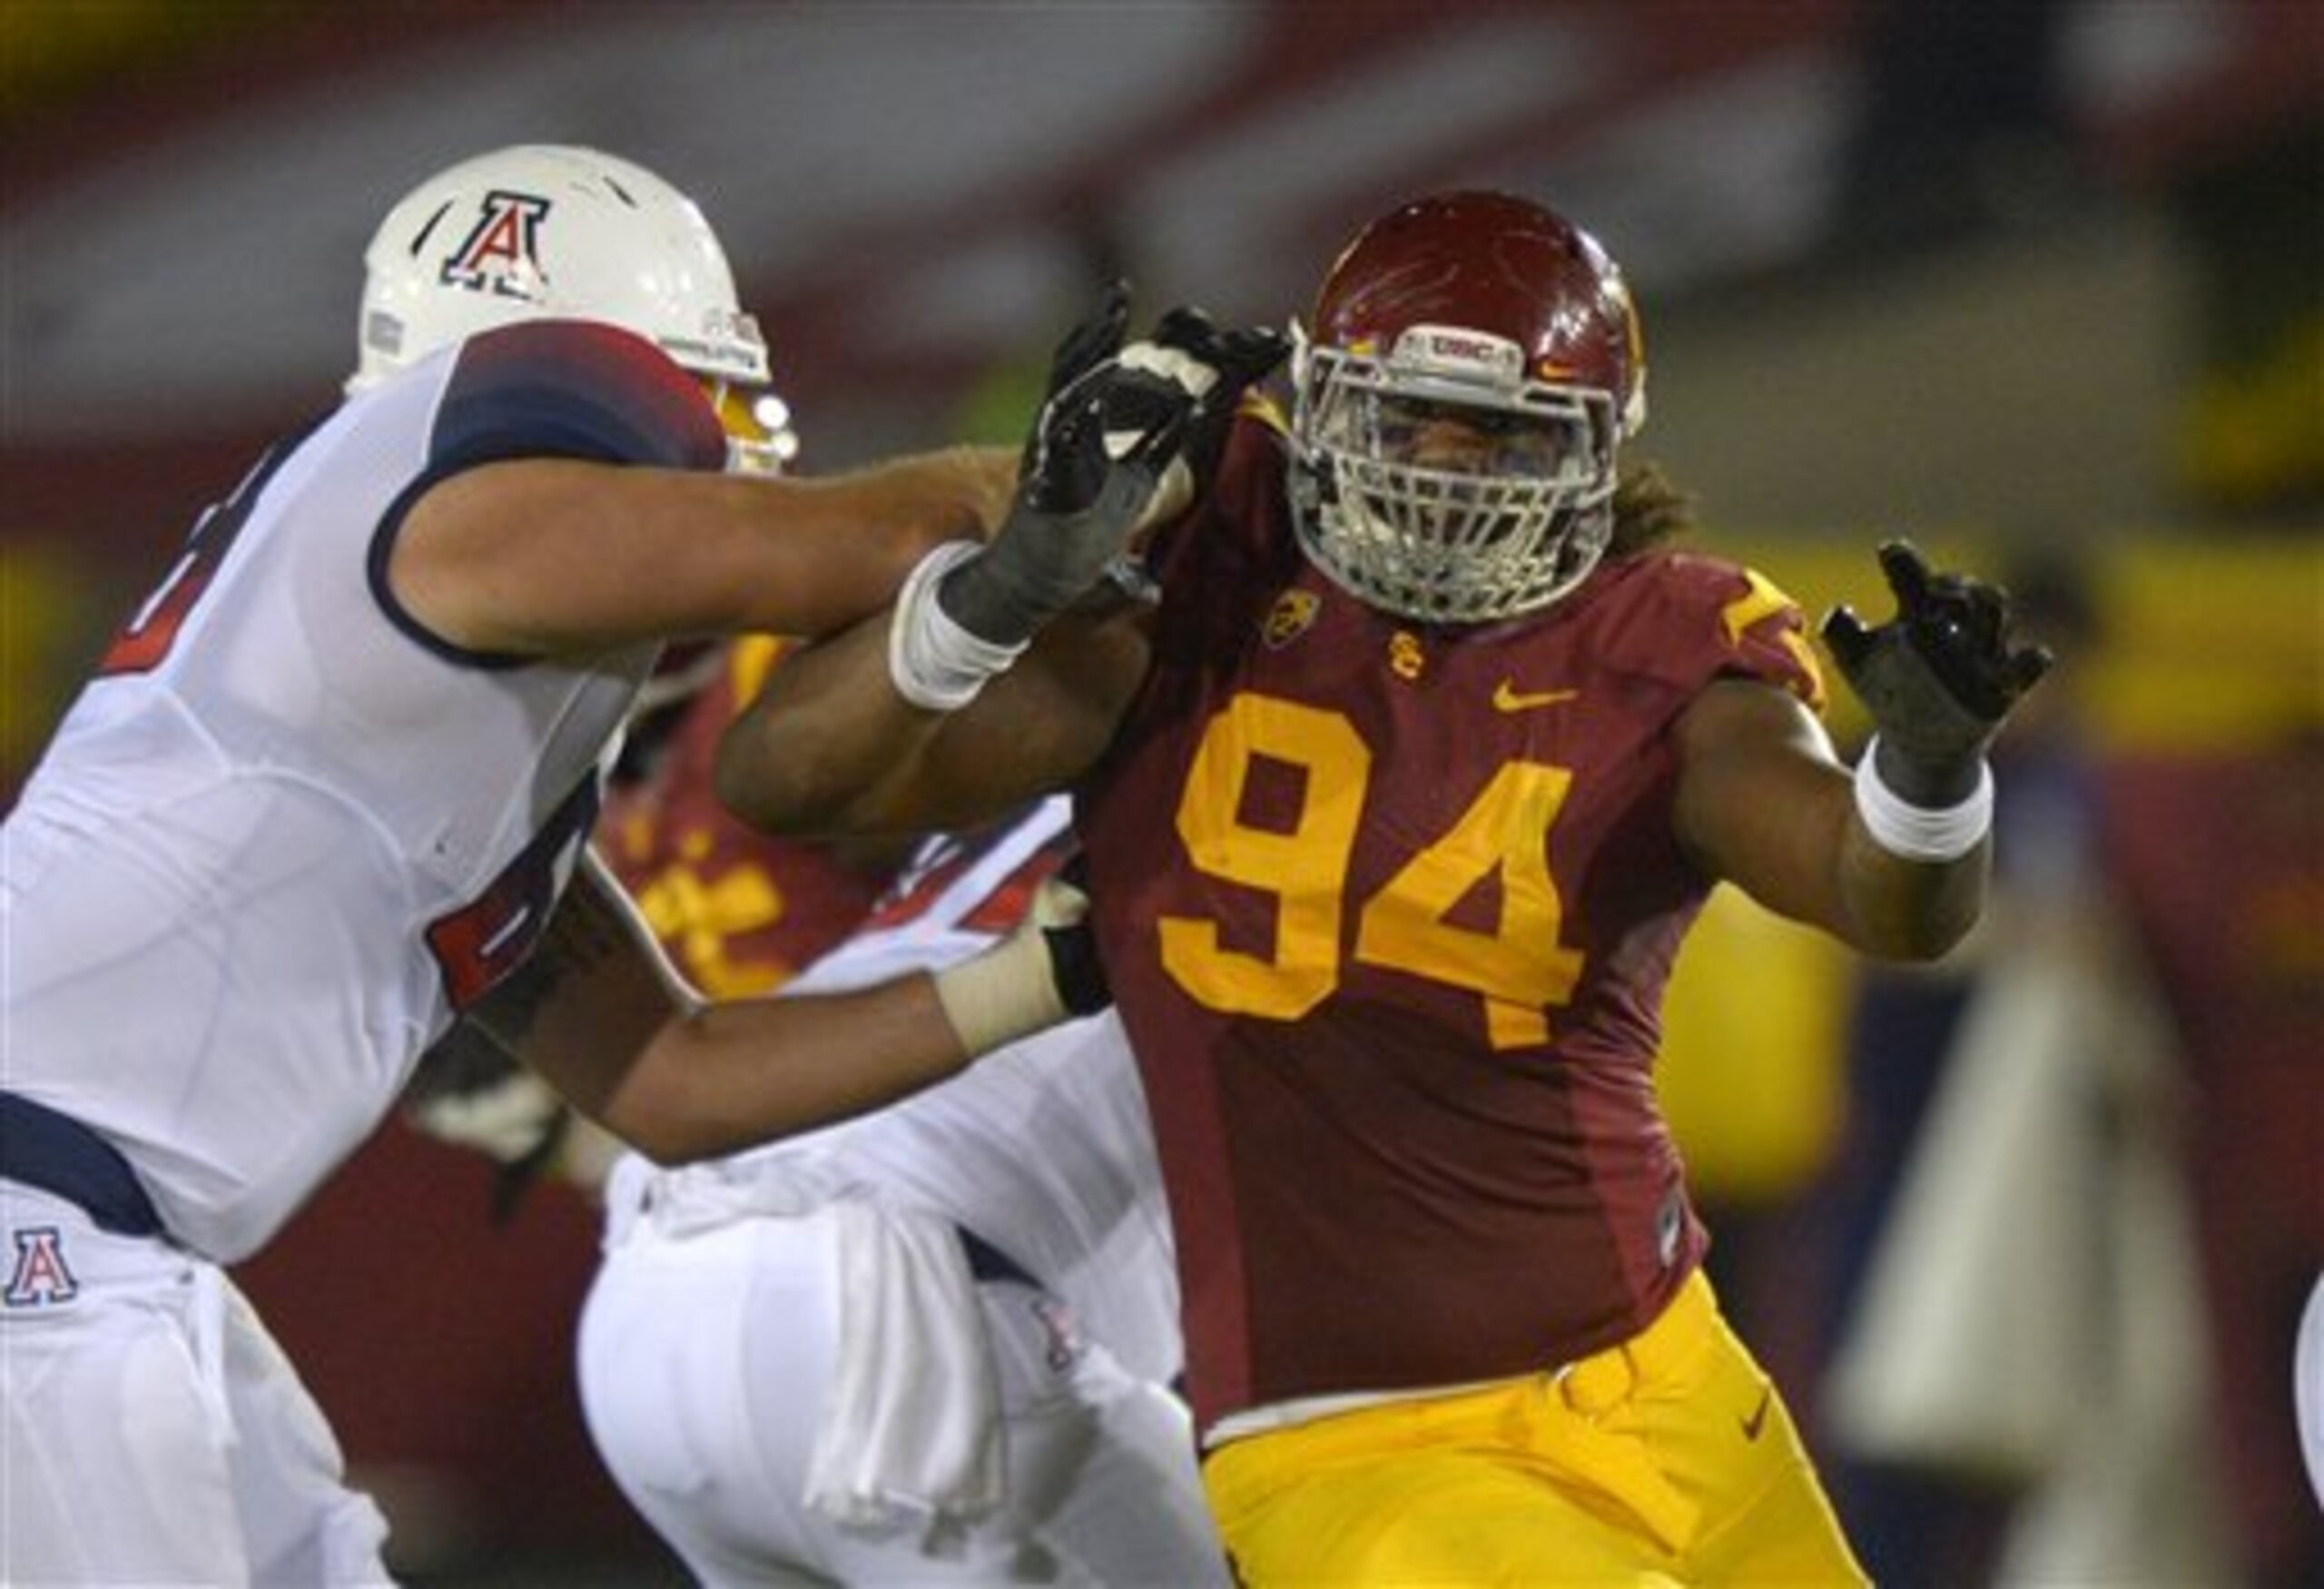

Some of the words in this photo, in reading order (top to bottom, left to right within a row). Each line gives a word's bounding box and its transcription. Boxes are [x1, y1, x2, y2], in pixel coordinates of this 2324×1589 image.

[439, 189, 553, 301] A
[1157, 691, 1585, 1050] 94
[5, 1226, 79, 1307] A
